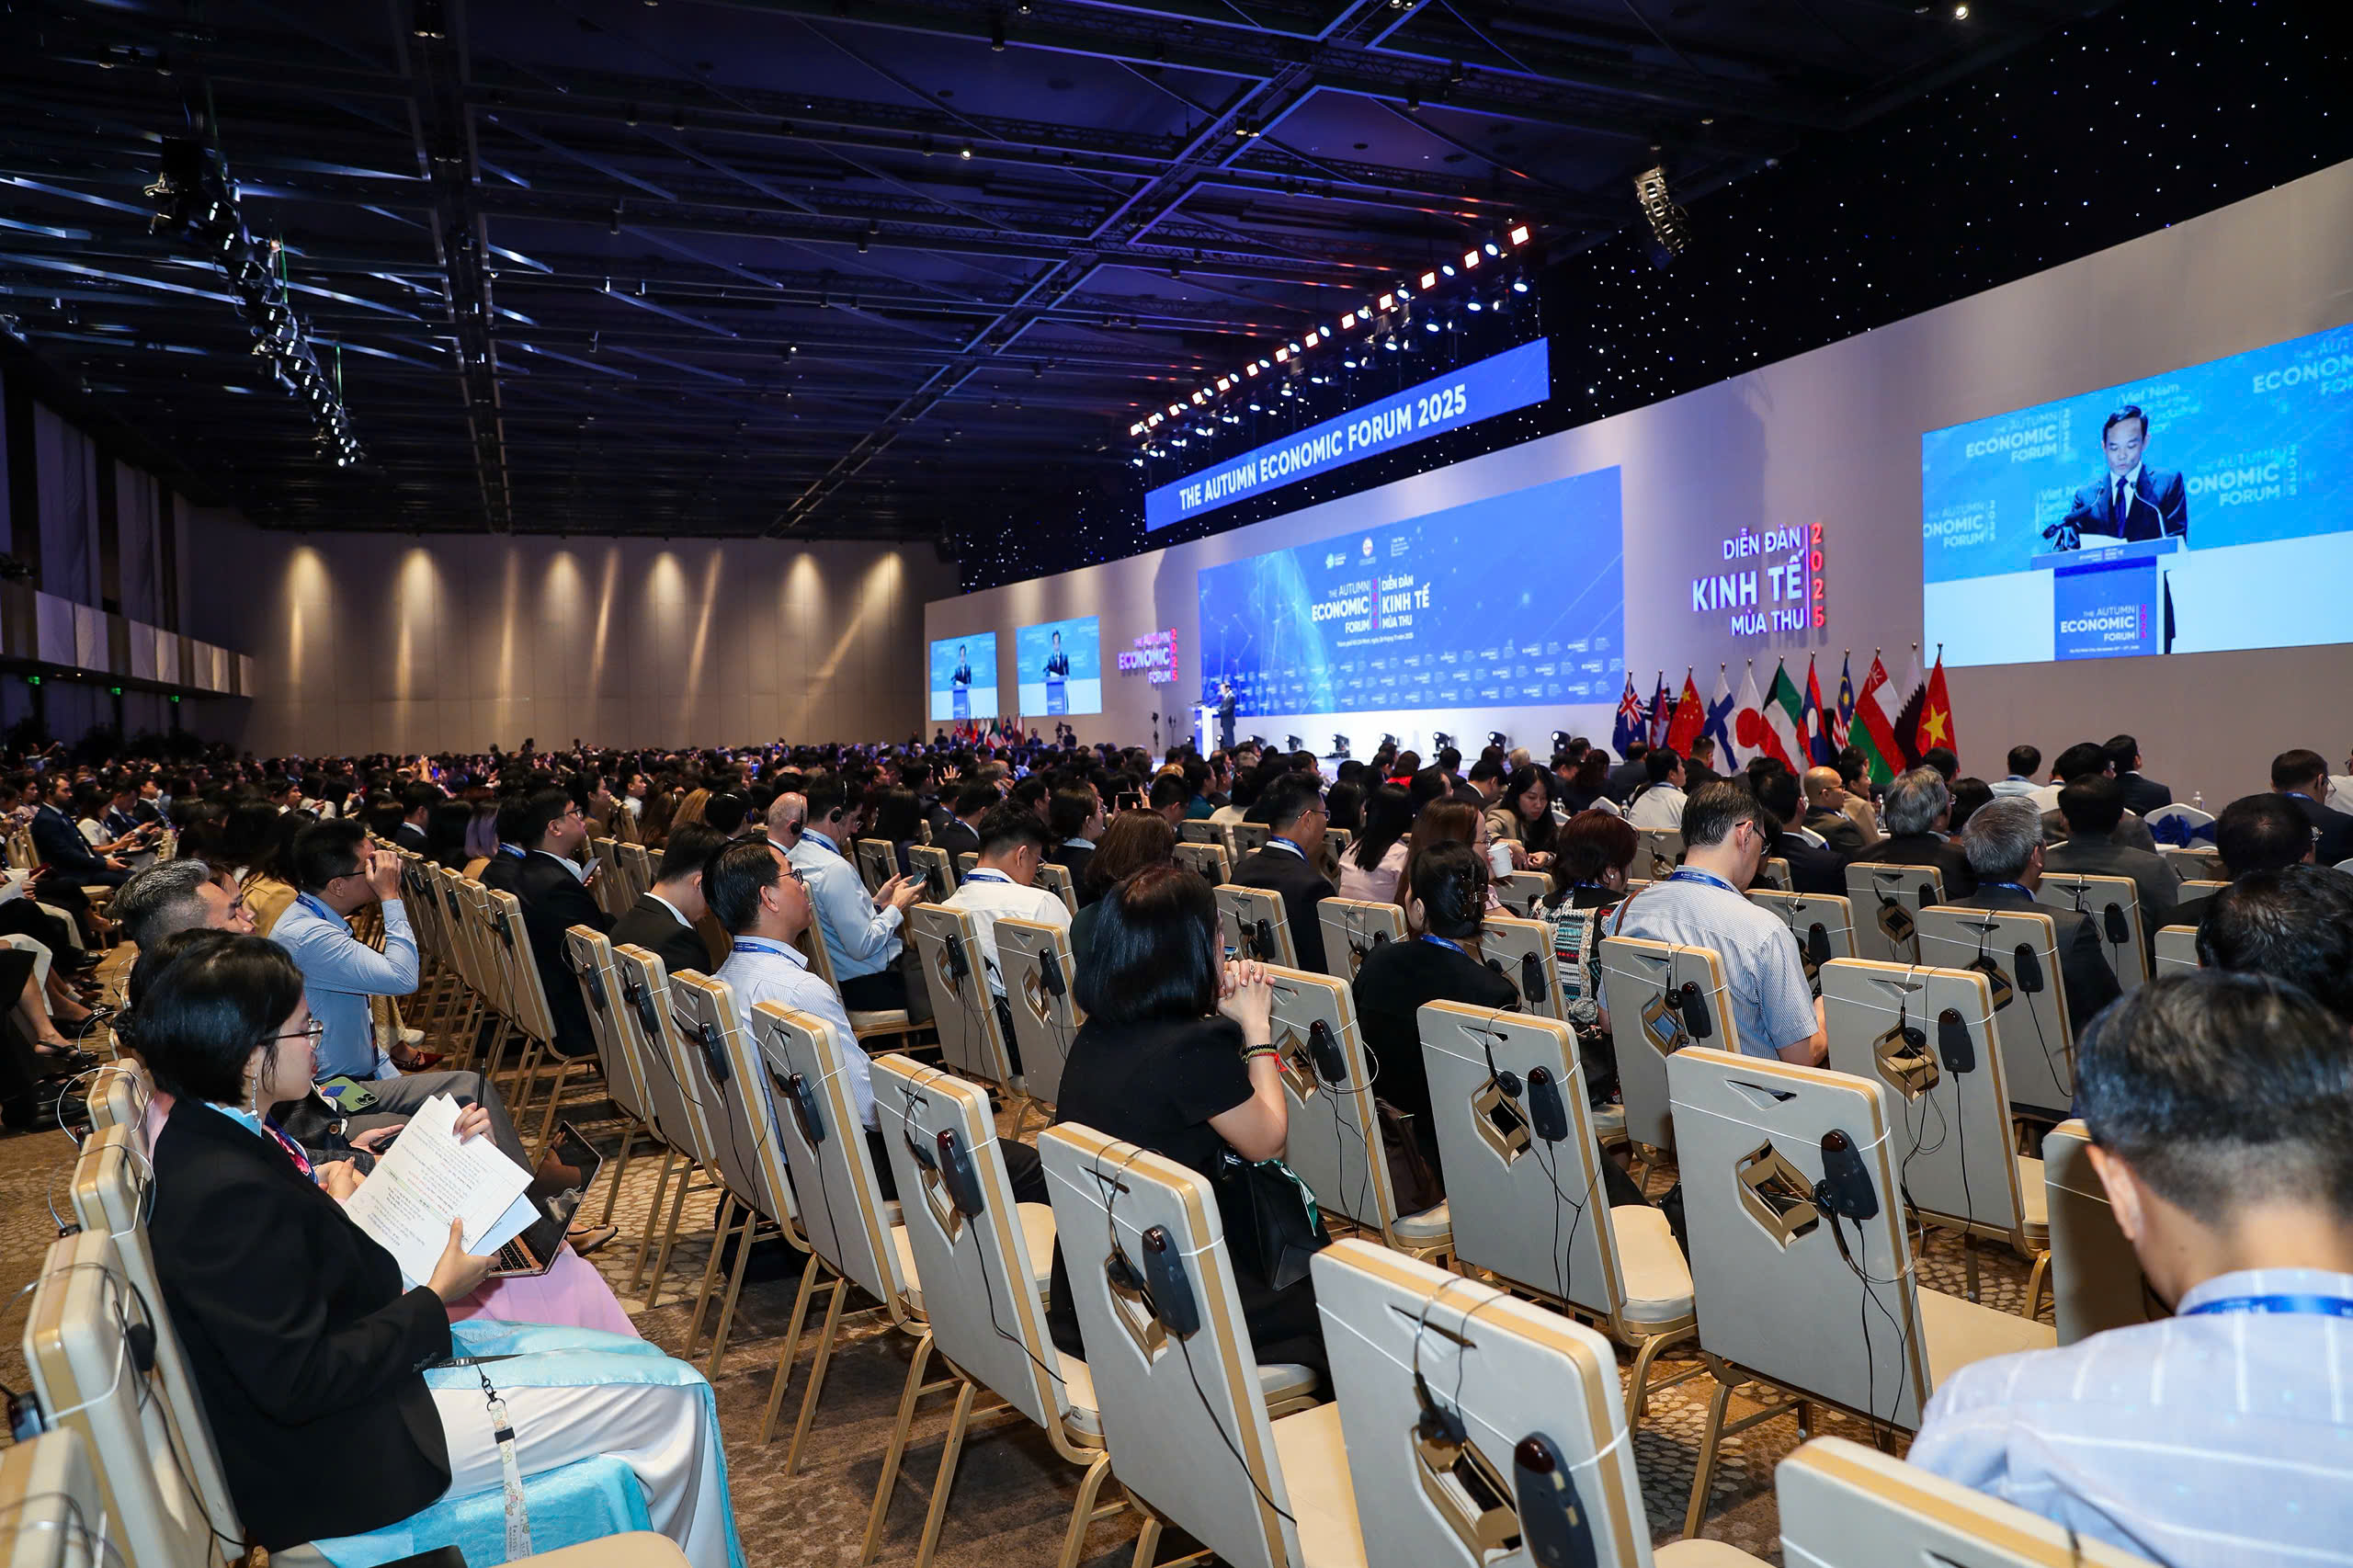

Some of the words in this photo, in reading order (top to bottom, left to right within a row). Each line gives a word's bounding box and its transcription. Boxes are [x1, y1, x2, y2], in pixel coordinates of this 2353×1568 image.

[1179, 483, 1201, 510] THE
[1204, 462, 1257, 499] AUTUMN
[1261, 430, 1343, 483] ECONOMIC
[1348, 404, 1412, 451] FORUM
[1418, 383, 1467, 427] 2025
[1965, 424, 2056, 459] ECONOMIC
[2011, 442, 2057, 463] FORUM
[2187, 462, 2279, 494] ONOMIC
[2220, 484, 2280, 506] FORUM
[1722, 527, 1759, 560] DIỄN
[1764, 524, 1802, 552] ĐÀN
[1943, 533, 1984, 549] FORUM
[1692, 570, 1757, 612] KINH
[1767, 549, 1805, 602] TẾ
[1810, 522, 1825, 628] 2025
[1338, 580, 1370, 597] AUTUMN
[1381, 593, 1412, 614] KINH
[1414, 582, 1431, 608] TẾ
[1312, 596, 1370, 622] ECONOMIC
[2096, 605, 2135, 617] AUTUMN
[1345, 619, 1370, 634] FORUM
[1381, 615, 1398, 630] MÙA
[1398, 615, 1413, 627] THU
[1731, 608, 1768, 636] MÙA
[1770, 608, 1804, 631] THU
[2060, 616, 2135, 633] ECONOMIC
[2104, 631, 2135, 642] FORUM
[1118, 646, 1170, 669] ECONOMIC
[1148, 670, 1172, 684] FORUM
